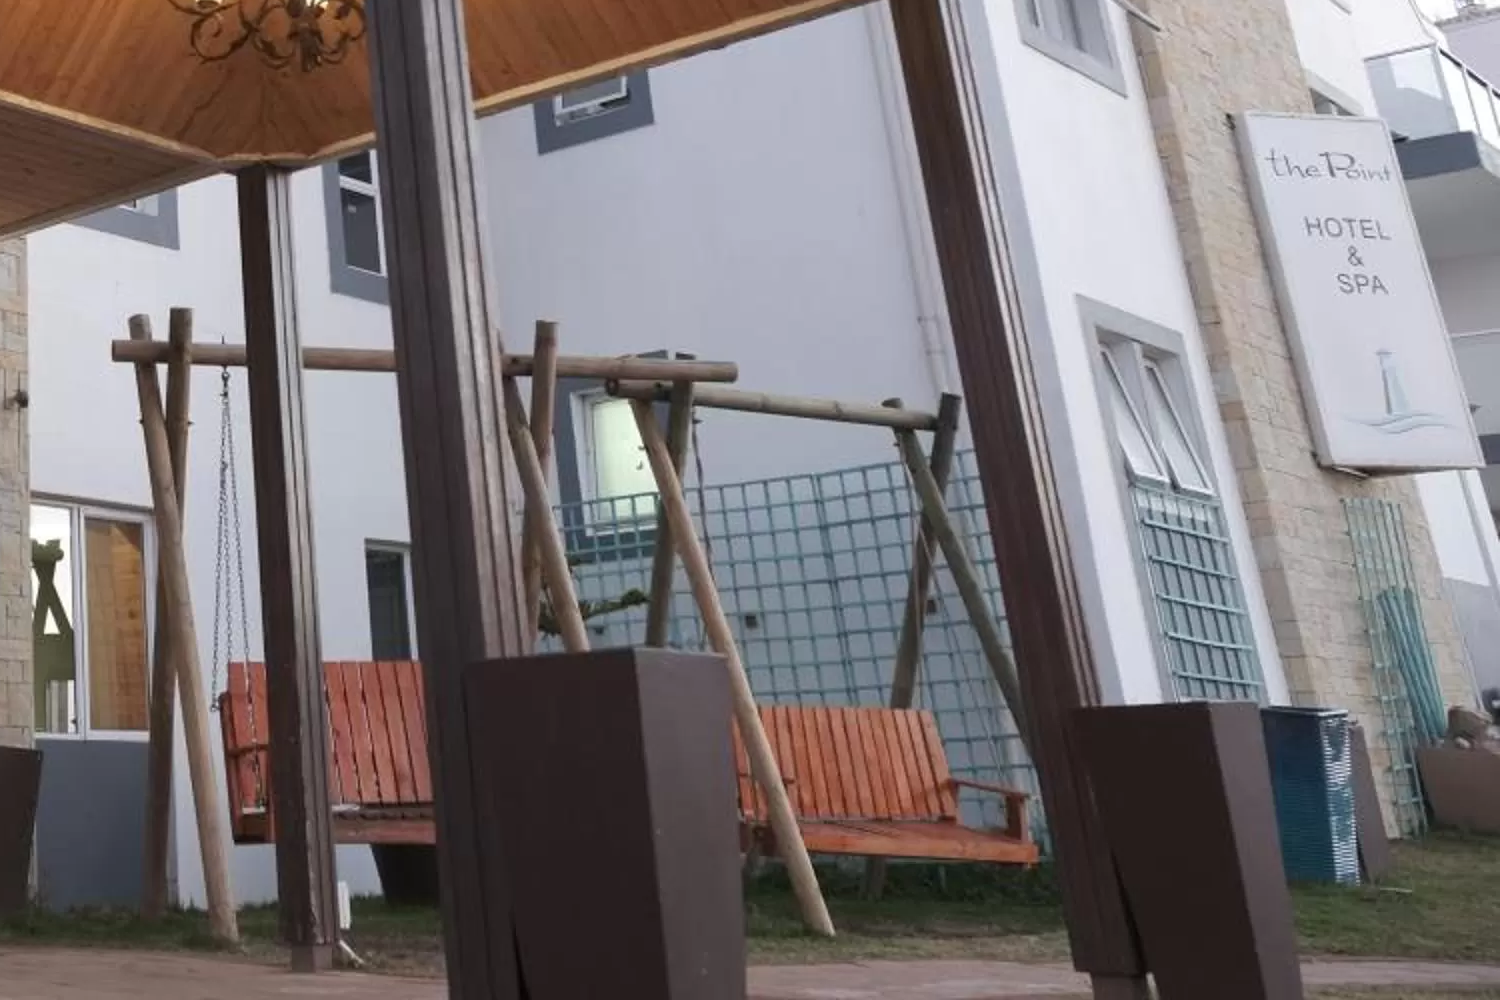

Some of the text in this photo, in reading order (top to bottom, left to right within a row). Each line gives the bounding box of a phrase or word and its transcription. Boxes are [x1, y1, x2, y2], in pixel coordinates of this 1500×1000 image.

[1264, 147, 1391, 182] the Point
[1304, 216, 1392, 240] HOTEL
[1347, 245, 1365, 267] &
[1337, 273, 1389, 295] SPA
